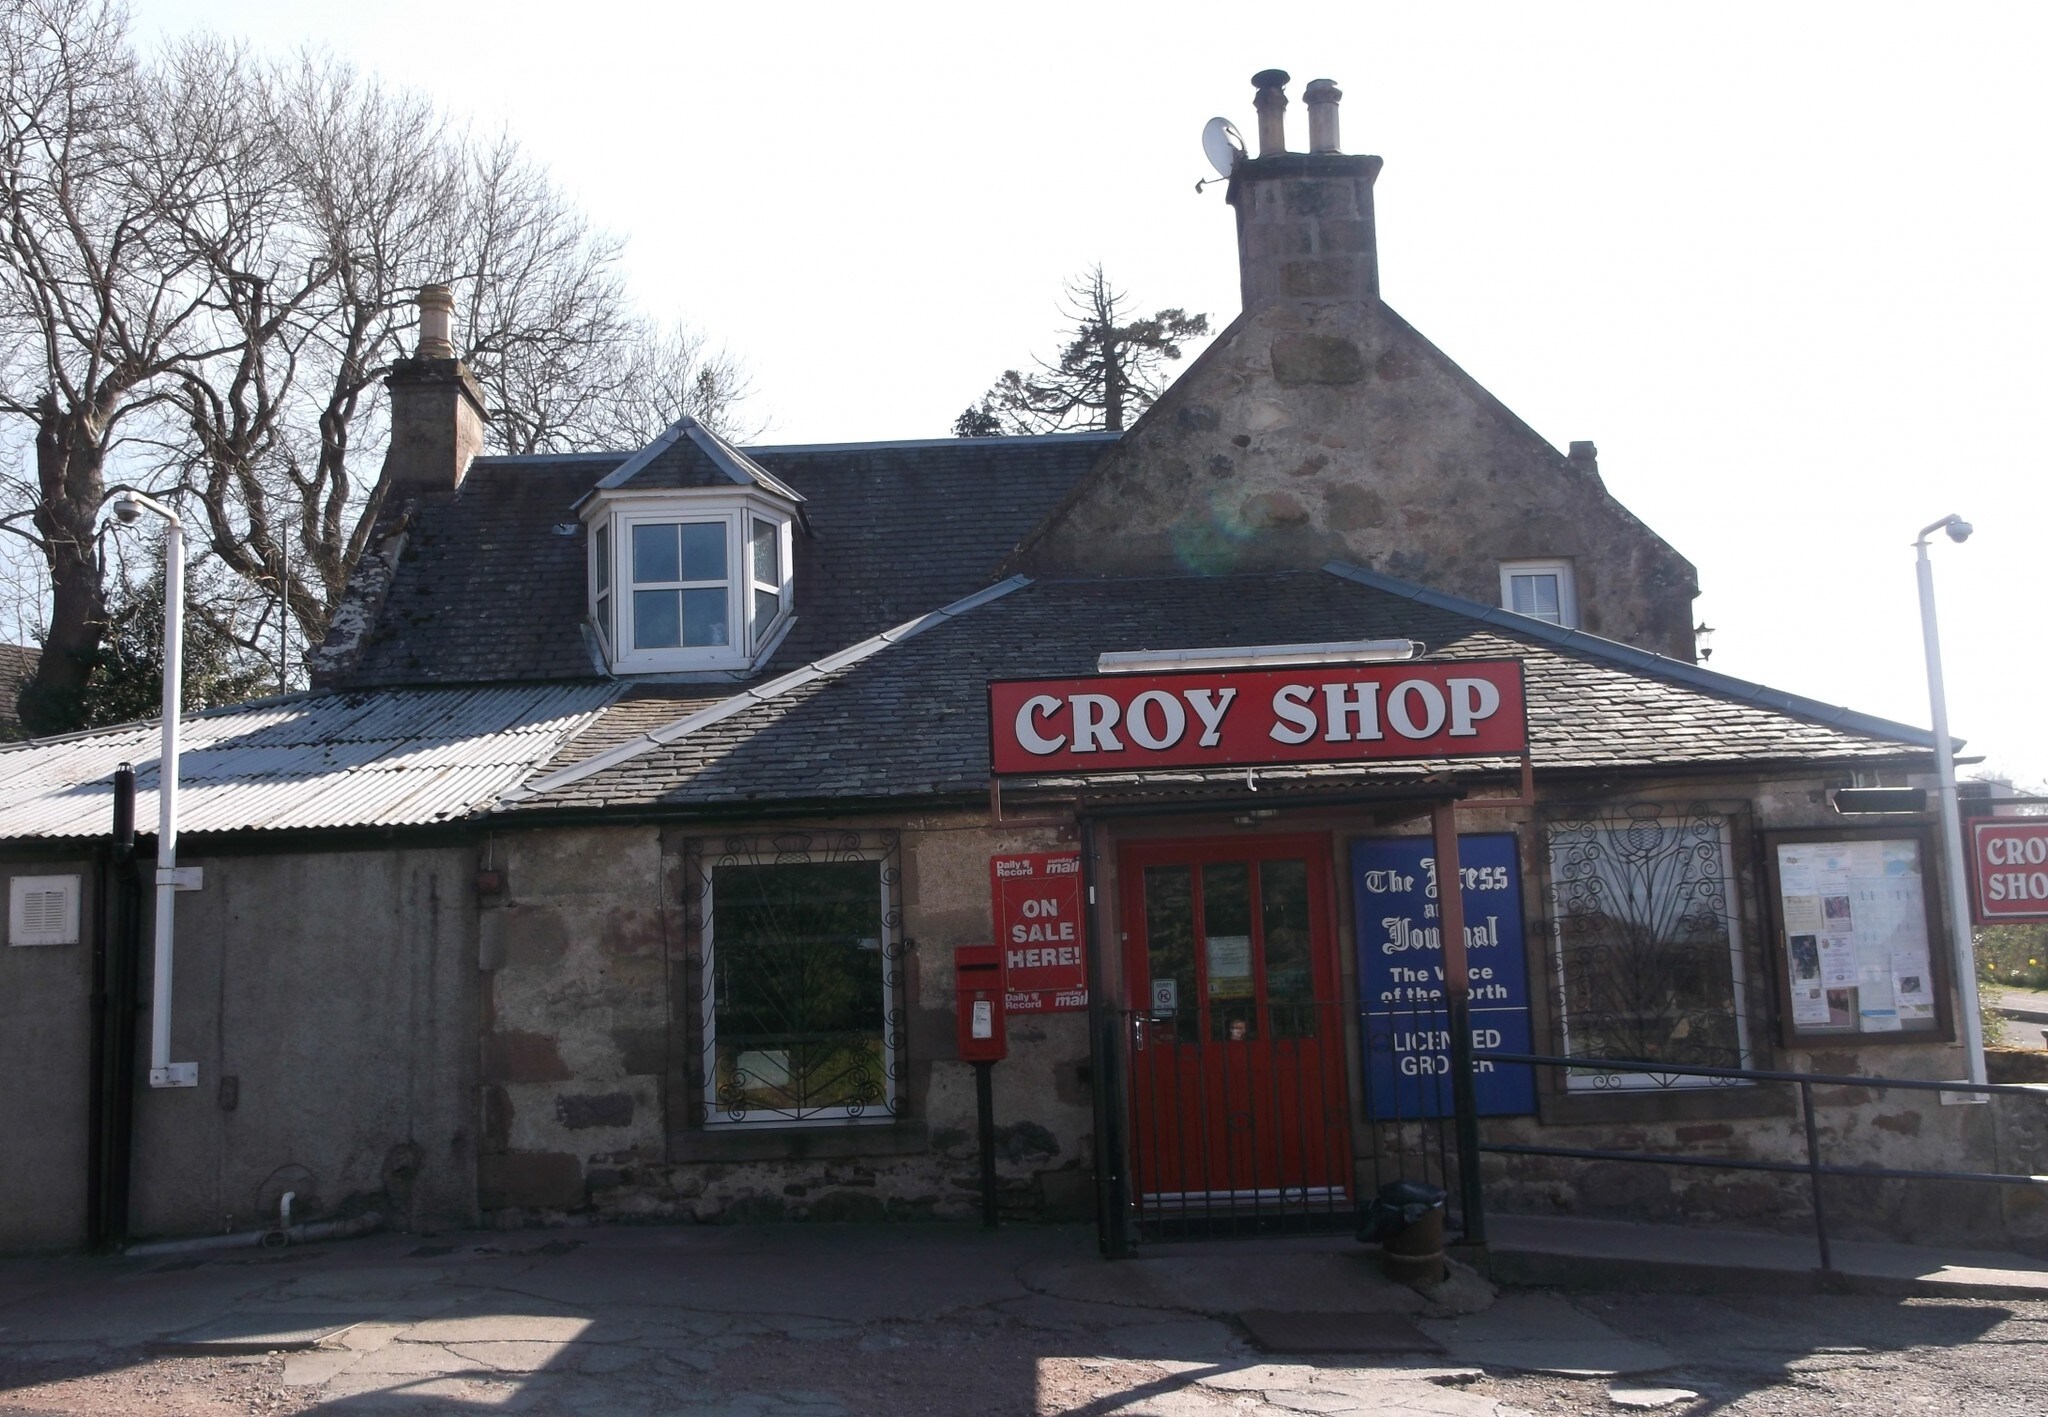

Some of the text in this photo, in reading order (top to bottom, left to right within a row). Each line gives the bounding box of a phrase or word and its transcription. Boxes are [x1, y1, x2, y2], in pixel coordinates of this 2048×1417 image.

[1015, 678, 1500, 755] CROY SHOP
[1986, 837, 2048, 865] CRO
[996, 861, 1021, 870] Daily
[997, 867, 1033, 877] Record
[1046, 857, 1081, 874] mail
[1365, 870, 1414, 893] The
[1022, 899, 1058, 918] ON
[1012, 922, 1074, 943] SALE
[1382, 916, 1499, 955] Jounal
[1008, 947, 1081, 969] HERE!
[1390, 967, 1429, 983] The
[1005, 993, 1030, 1002] Daily
[1055, 990, 1089, 1007] mail
[1380, 984, 1508, 1004] of the orth
[1006, 1000, 1042, 1010] Record
[1393, 1029, 1501, 1052] LICENED
